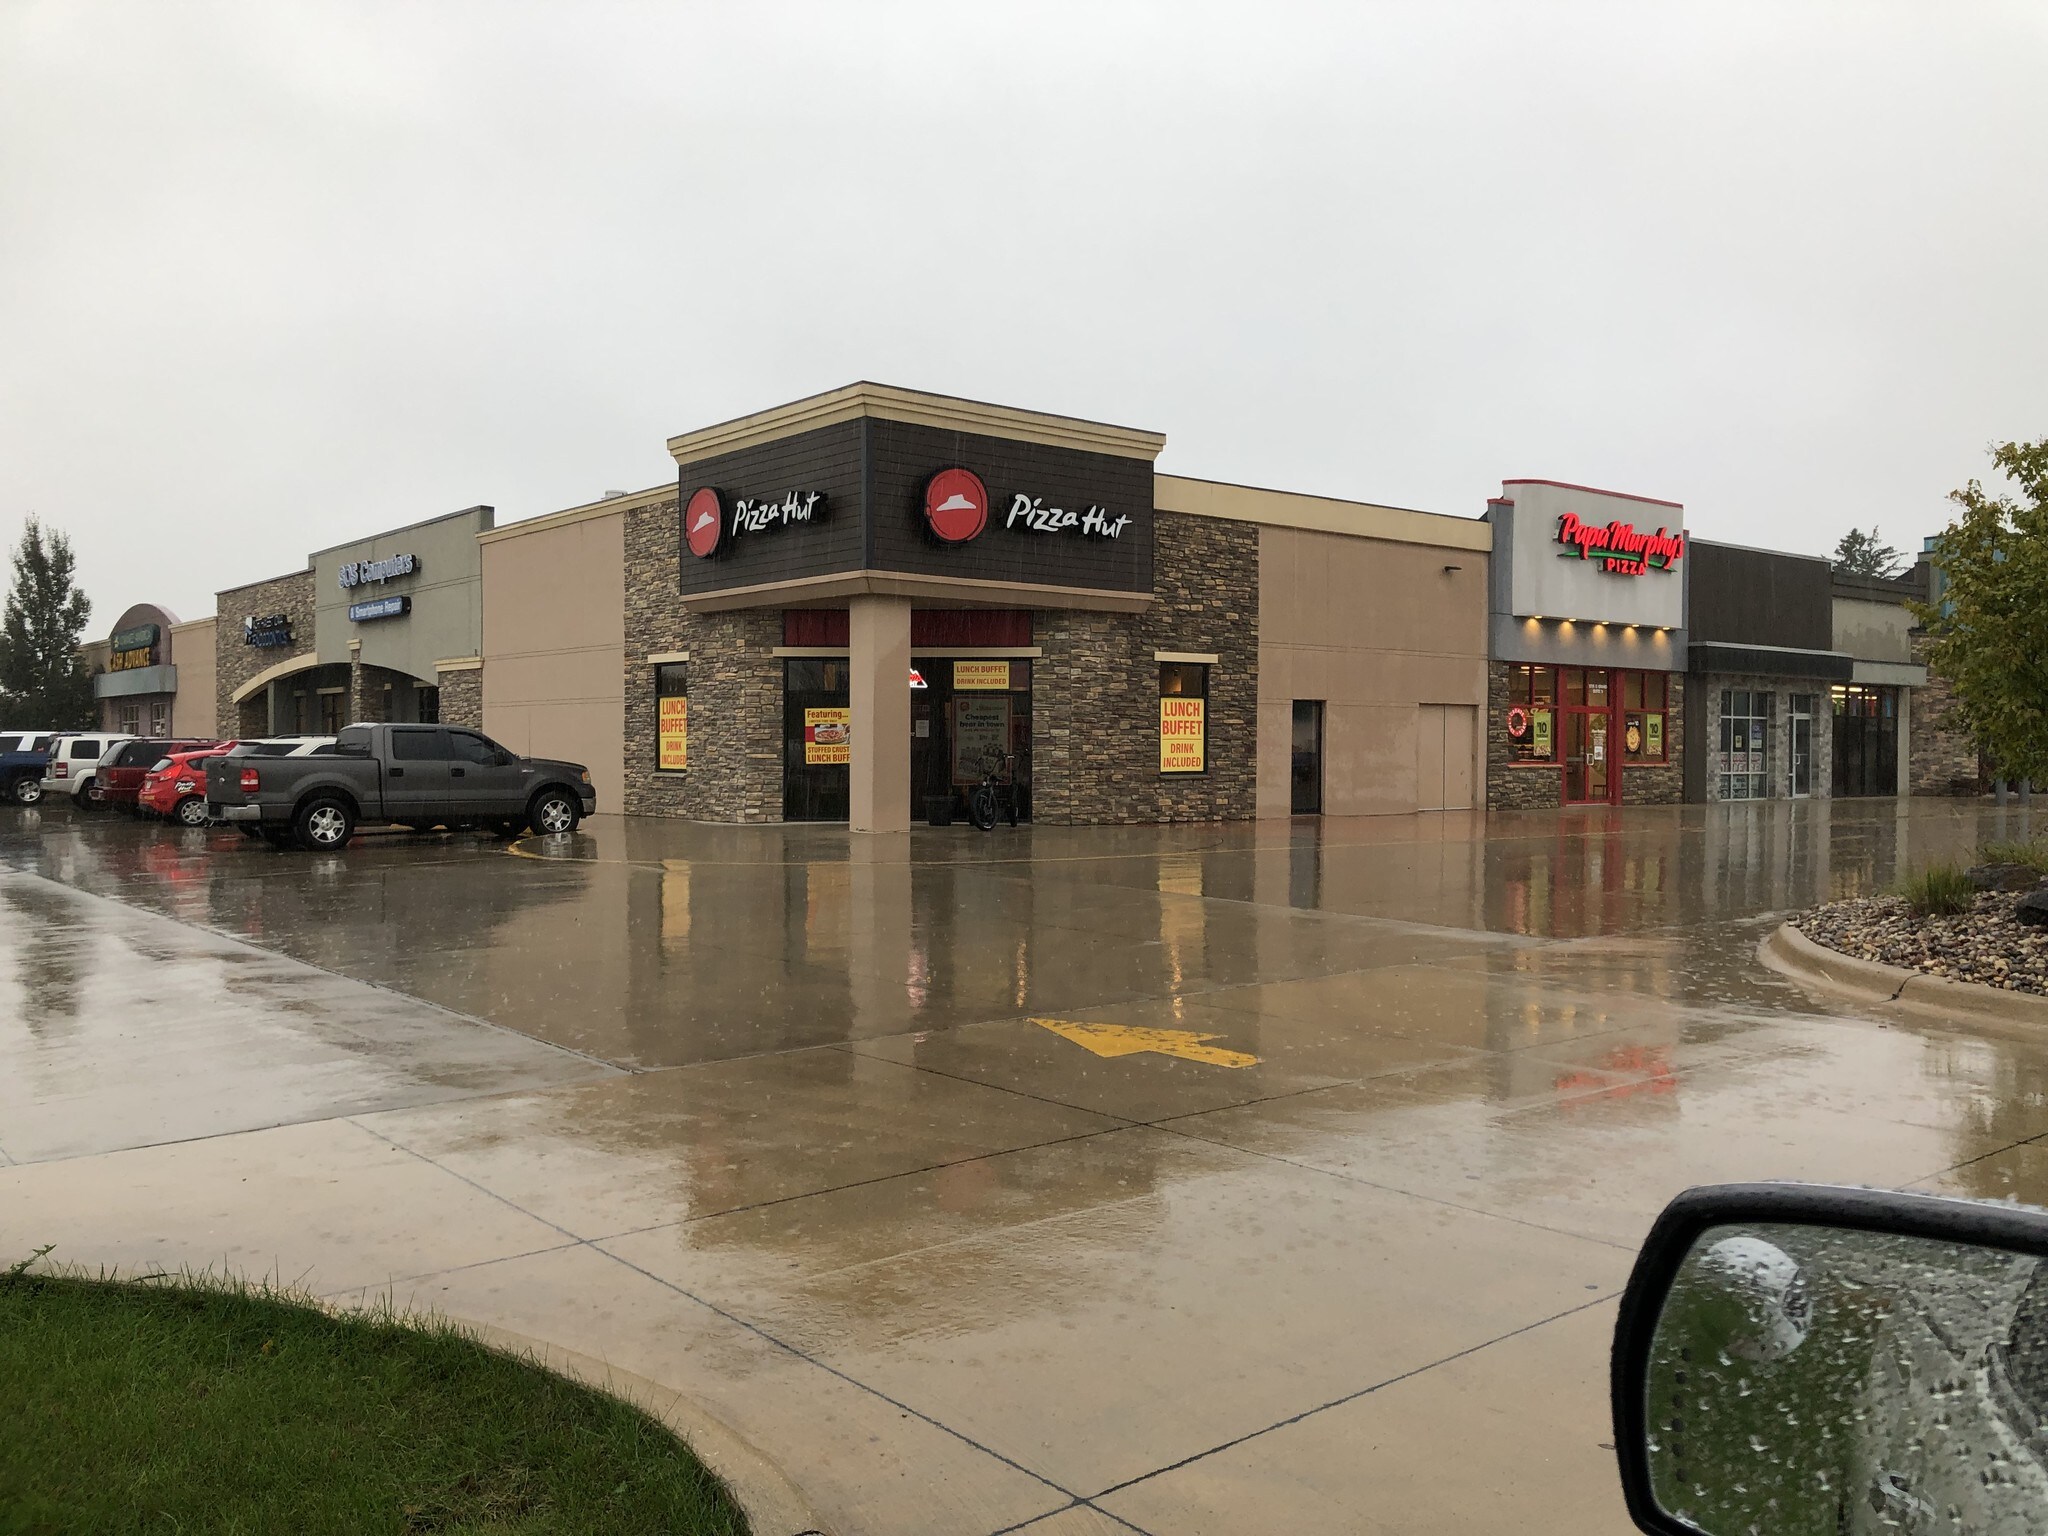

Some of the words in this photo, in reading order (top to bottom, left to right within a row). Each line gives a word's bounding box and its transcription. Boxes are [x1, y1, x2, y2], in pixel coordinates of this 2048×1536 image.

[733, 499, 780, 537] Pizza
[781, 490, 821, 525] Hut
[1006, 493, 1079, 532] Pizza
[1081, 505, 1133, 539] Hut
[1561, 512, 1609, 560] Papa
[1609, 520, 1684, 570] Murphy's
[338, 562, 359, 589] SOS
[360, 553, 413, 584] Computers
[1606, 558, 1647, 576] PIZZA
[355, 604, 384, 618] Smartphone
[384, 598, 402, 614] Repair
[957, 665, 980, 673] LUNCH
[981, 665, 1007, 673] BUFFET
[662, 700, 686, 715] LUNCH
[1164, 701, 1200, 717] LUNCH
[661, 718, 688, 733] BUFFET
[1162, 720, 1202, 735] BUFFET
[665, 740, 682, 751] DRINK
[1170, 743, 1195, 753] DRINK
[661, 754, 687, 765] INCLUDED
[807, 754, 831, 762] LUNCH
[832, 754, 850, 762] BUFF
[1163, 757, 1202, 767] INCLUDED
